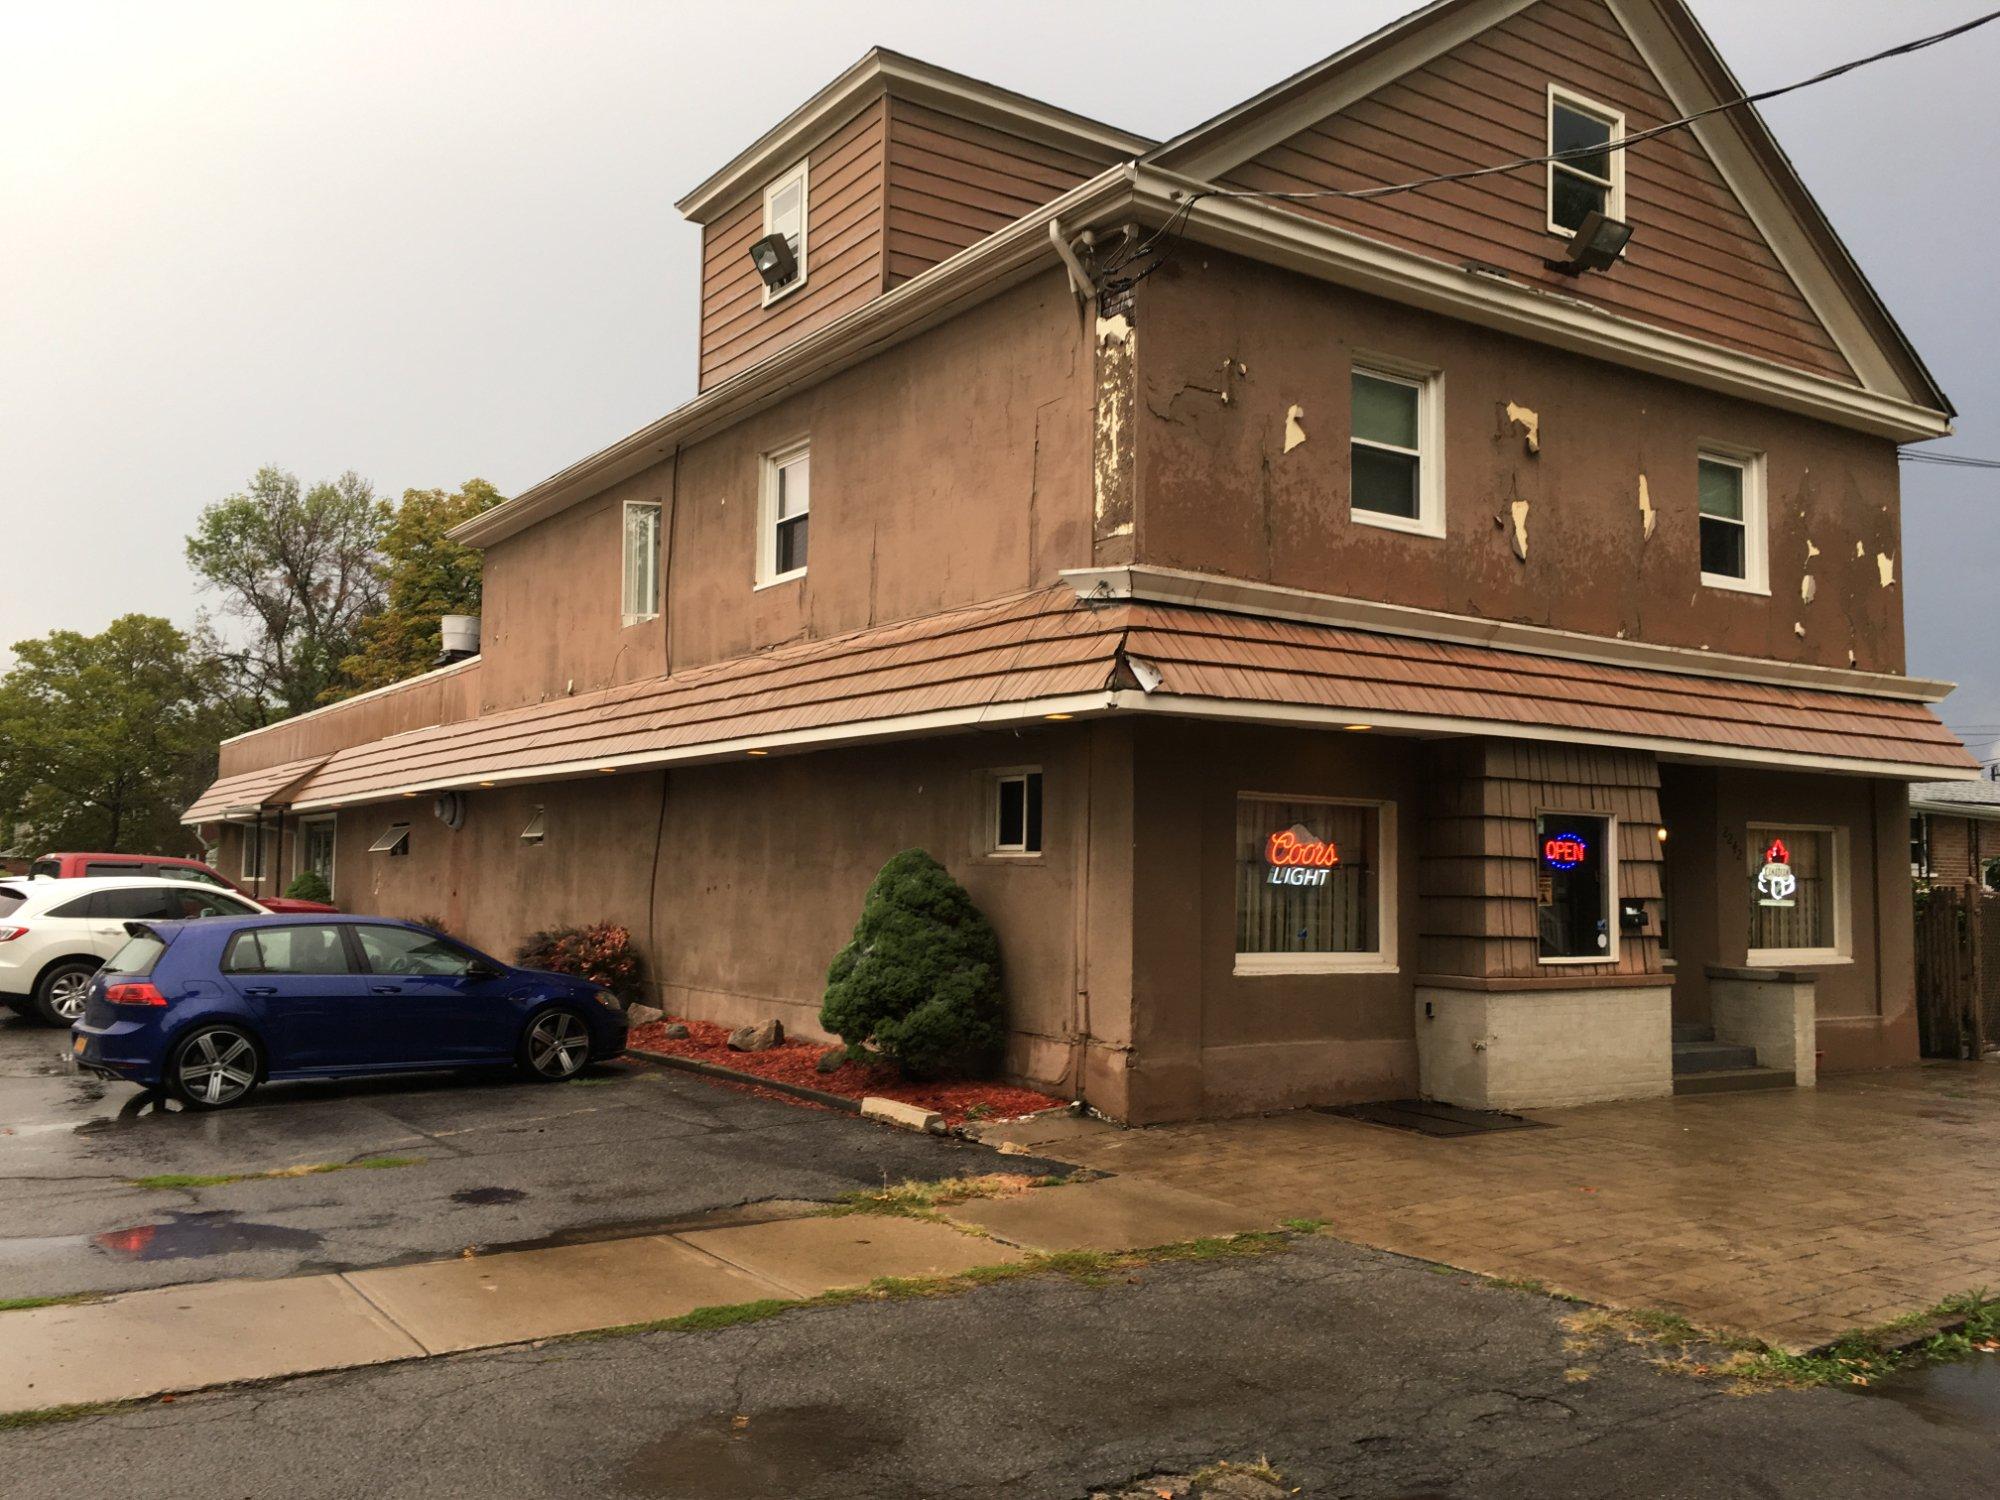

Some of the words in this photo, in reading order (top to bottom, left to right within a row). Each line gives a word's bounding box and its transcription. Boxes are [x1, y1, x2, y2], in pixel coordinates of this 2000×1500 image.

[1271, 832, 1338, 865] Coors
[1546, 841, 1585, 862] OPEN
[1272, 867, 1330, 886] LIGHT
